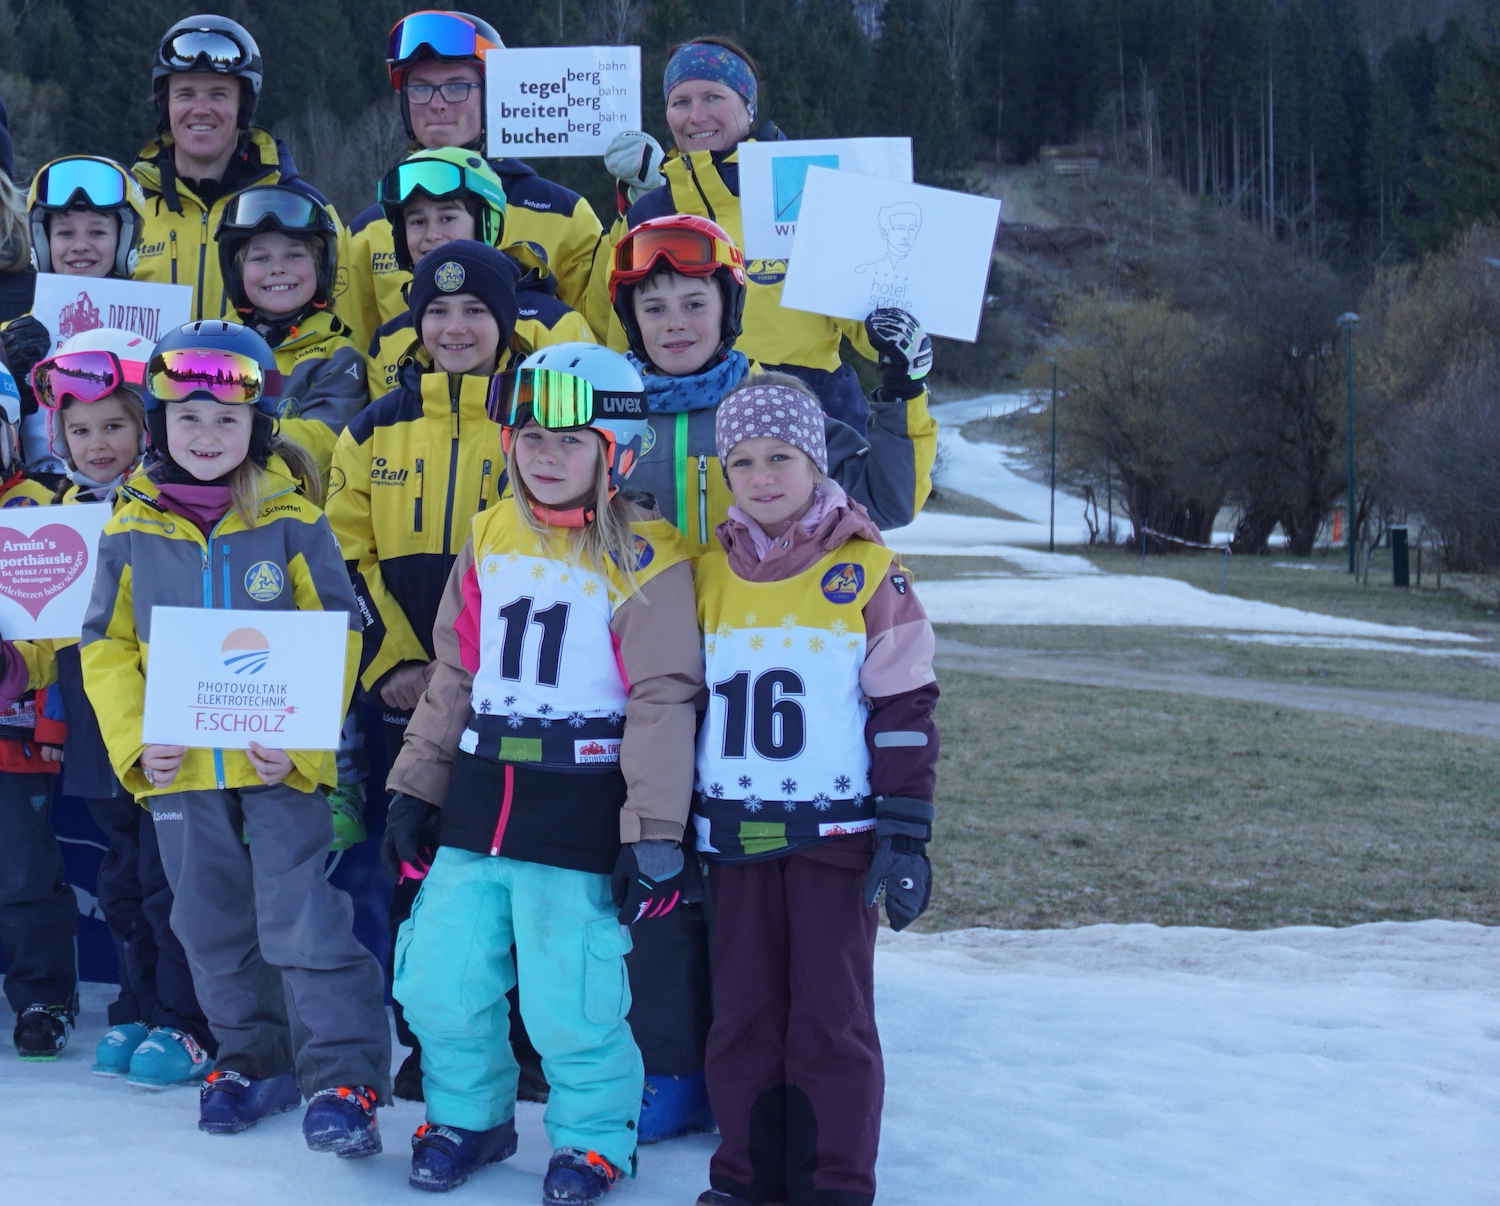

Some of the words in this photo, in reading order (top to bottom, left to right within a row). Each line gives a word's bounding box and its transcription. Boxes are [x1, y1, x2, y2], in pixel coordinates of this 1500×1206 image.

[520, 77, 566, 99] tegel
[567, 68, 600, 85] berg
[599, 61, 627, 71] bahn
[501, 102, 568, 118] breiten
[567, 94, 601, 110] berg
[599, 87, 627, 96] bahn
[502, 127, 569, 144] buchen
[568, 119, 601, 136] berg
[599, 112, 627, 122] bahn
[523, 199, 551, 210] Schöffel
[775, 224, 796, 236] WI
[871, 279, 908, 298] hotel
[868, 293, 913, 313] sonne
[108, 304, 162, 344] DRIENDL
[603, 397, 642, 413] uvex
[371, 468, 409, 481] etall
[265, 503, 302, 517] Schöffel
[3, 539, 57, 552] Armin's
[15, 568, 38, 576] 08362
[43, 567, 66, 575] 81198
[64, 551, 84, 584] schlagen
[357, 595, 375, 627] buchen
[498, 595, 571, 688] 11
[198, 681, 288, 695] PHOTOVOLTAIK
[197, 693, 287, 707] ELEKTROTECHNIK
[195, 712, 286, 732] F.SCHOLZ
[712, 667, 807, 762] 16
